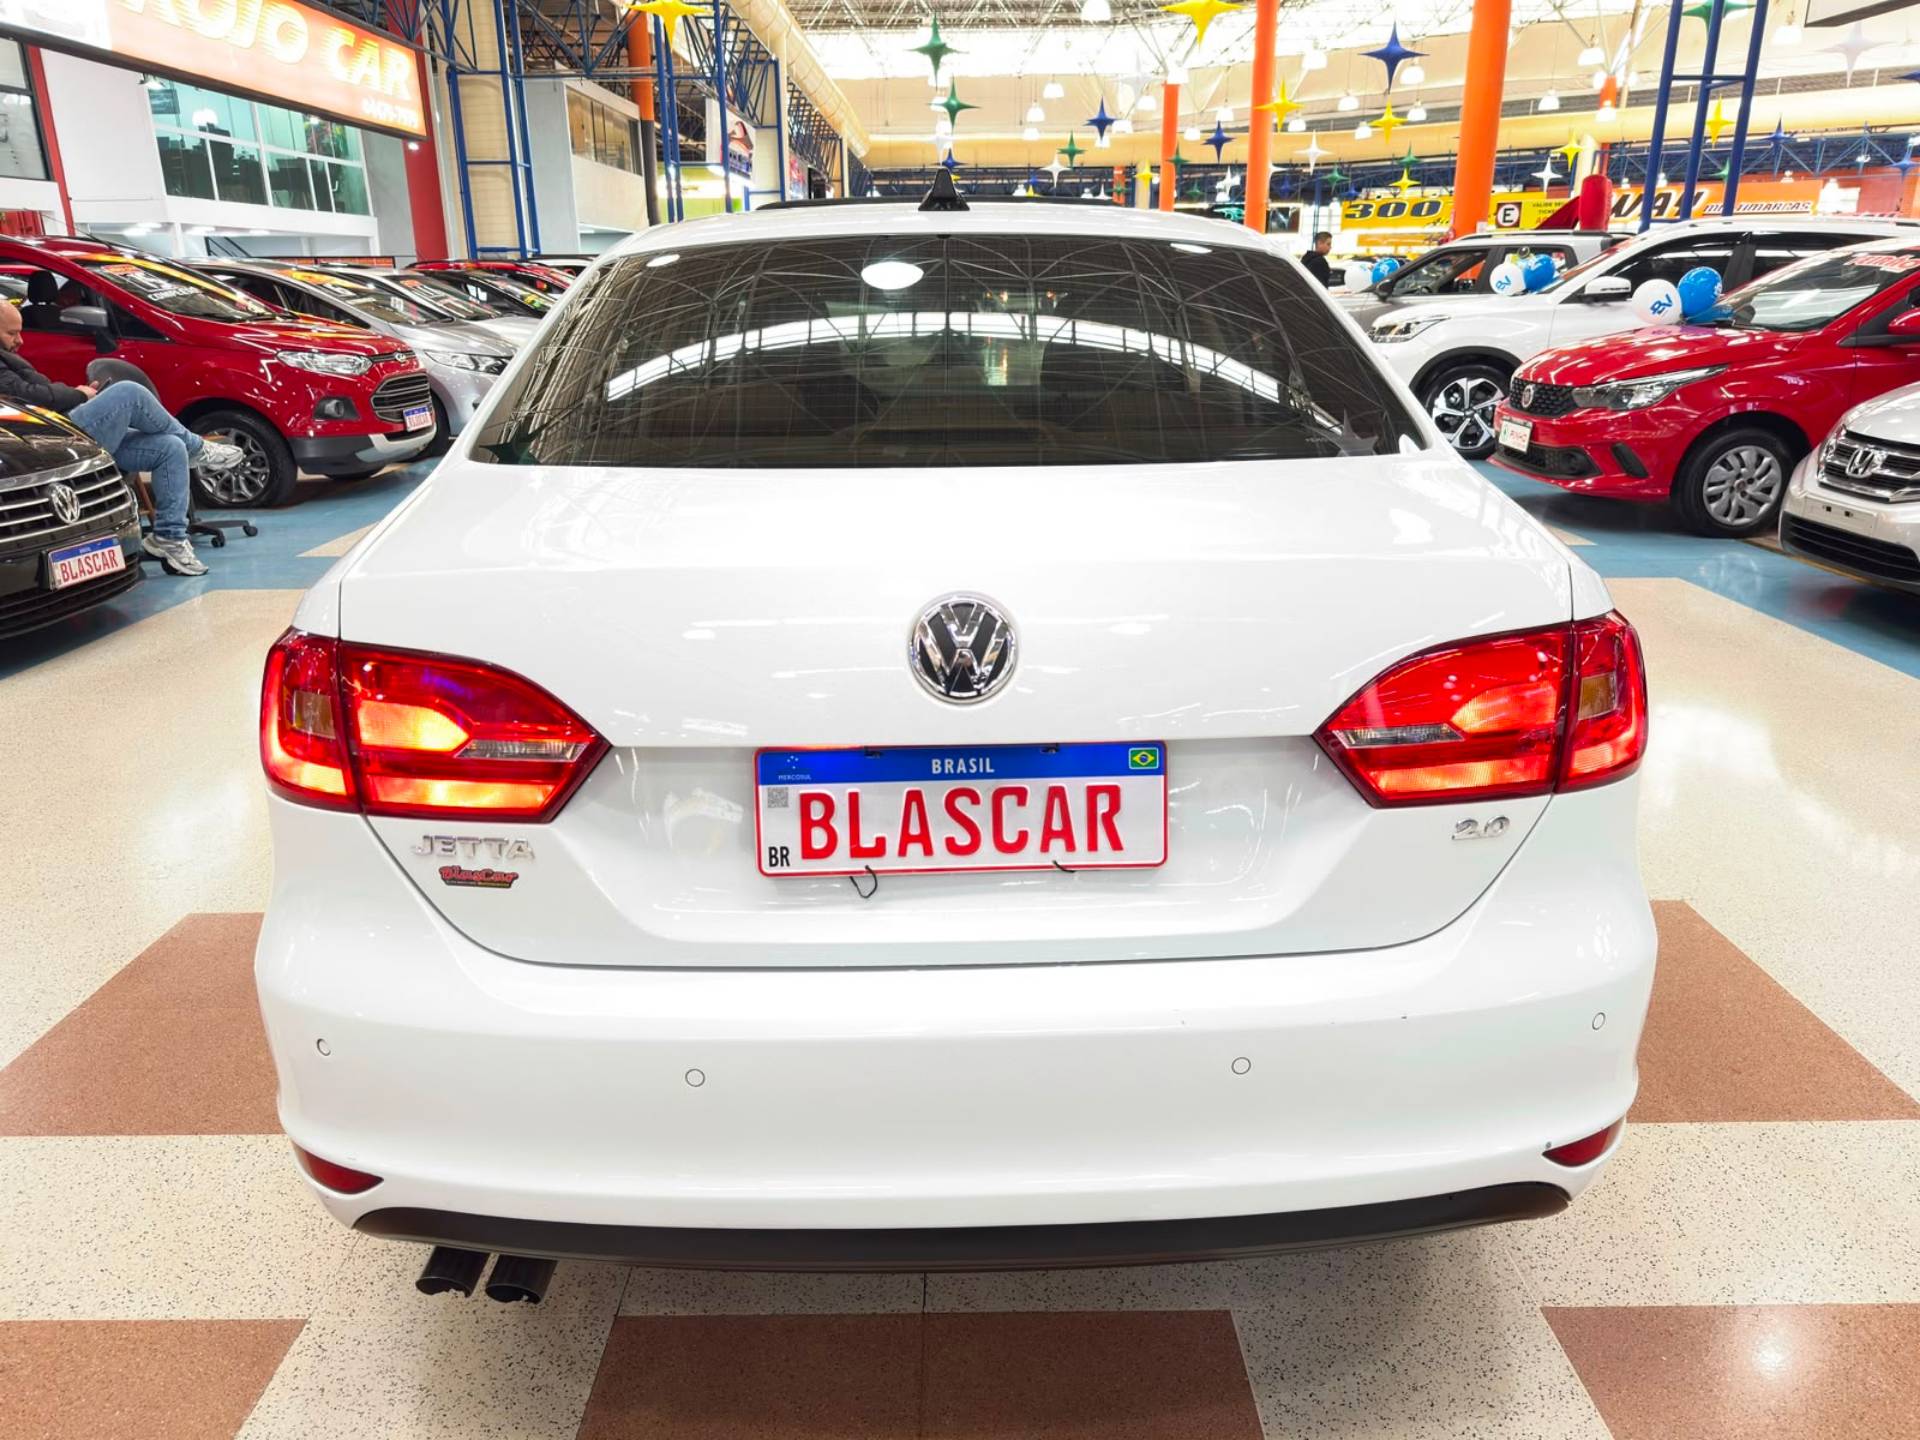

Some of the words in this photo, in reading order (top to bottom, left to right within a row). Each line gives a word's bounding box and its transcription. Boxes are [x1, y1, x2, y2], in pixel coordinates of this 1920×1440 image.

[325, 26, 412, 100] CAR
[1344, 199, 1442, 219] 300
[1502, 207, 1515, 224] E
[60, 549, 119, 583] BLASCAR
[931, 758, 995, 775] BRASIL
[799, 783, 1125, 861] BLASCAR
[1451, 814, 1511, 841] 2.0
[411, 834, 536, 860] JETTA
[768, 846, 791, 868] BR
